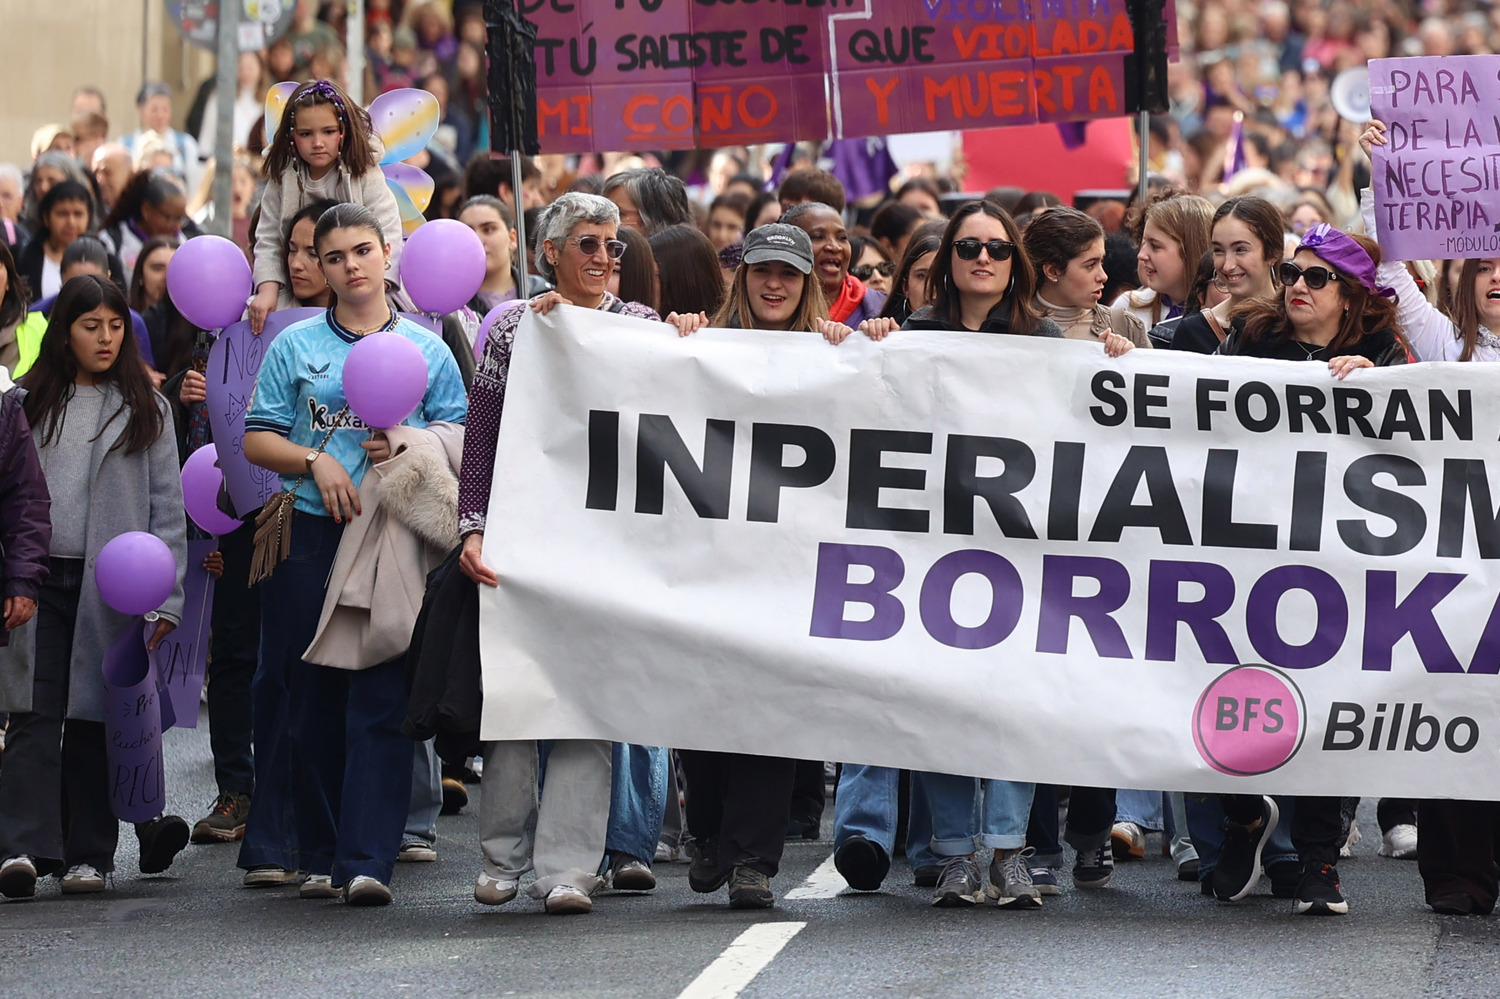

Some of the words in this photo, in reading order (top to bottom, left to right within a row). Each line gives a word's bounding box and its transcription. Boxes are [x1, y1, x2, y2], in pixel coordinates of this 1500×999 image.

[534, 22, 597, 77] TÚ
[615, 30, 748, 72] SALISTE
[759, 25, 810, 65] DE
[848, 26, 936, 64] QUE
[952, 12, 1135, 60] VIOLADA
[537, 95, 594, 138] MI
[621, 85, 778, 133] COÑO
[865, 76, 899, 127] Y
[923, 65, 1117, 122] MUERTA
[1390, 69, 1481, 108] PARA
[1390, 119, 1428, 153] DE
[1446, 118, 1482, 149] LA
[1089, 370, 1171, 429] SE
[1196, 377, 1474, 441] FORRAN
[1215, 697, 1284, 733] BFS
[1322, 702, 1480, 753] Bilbo
